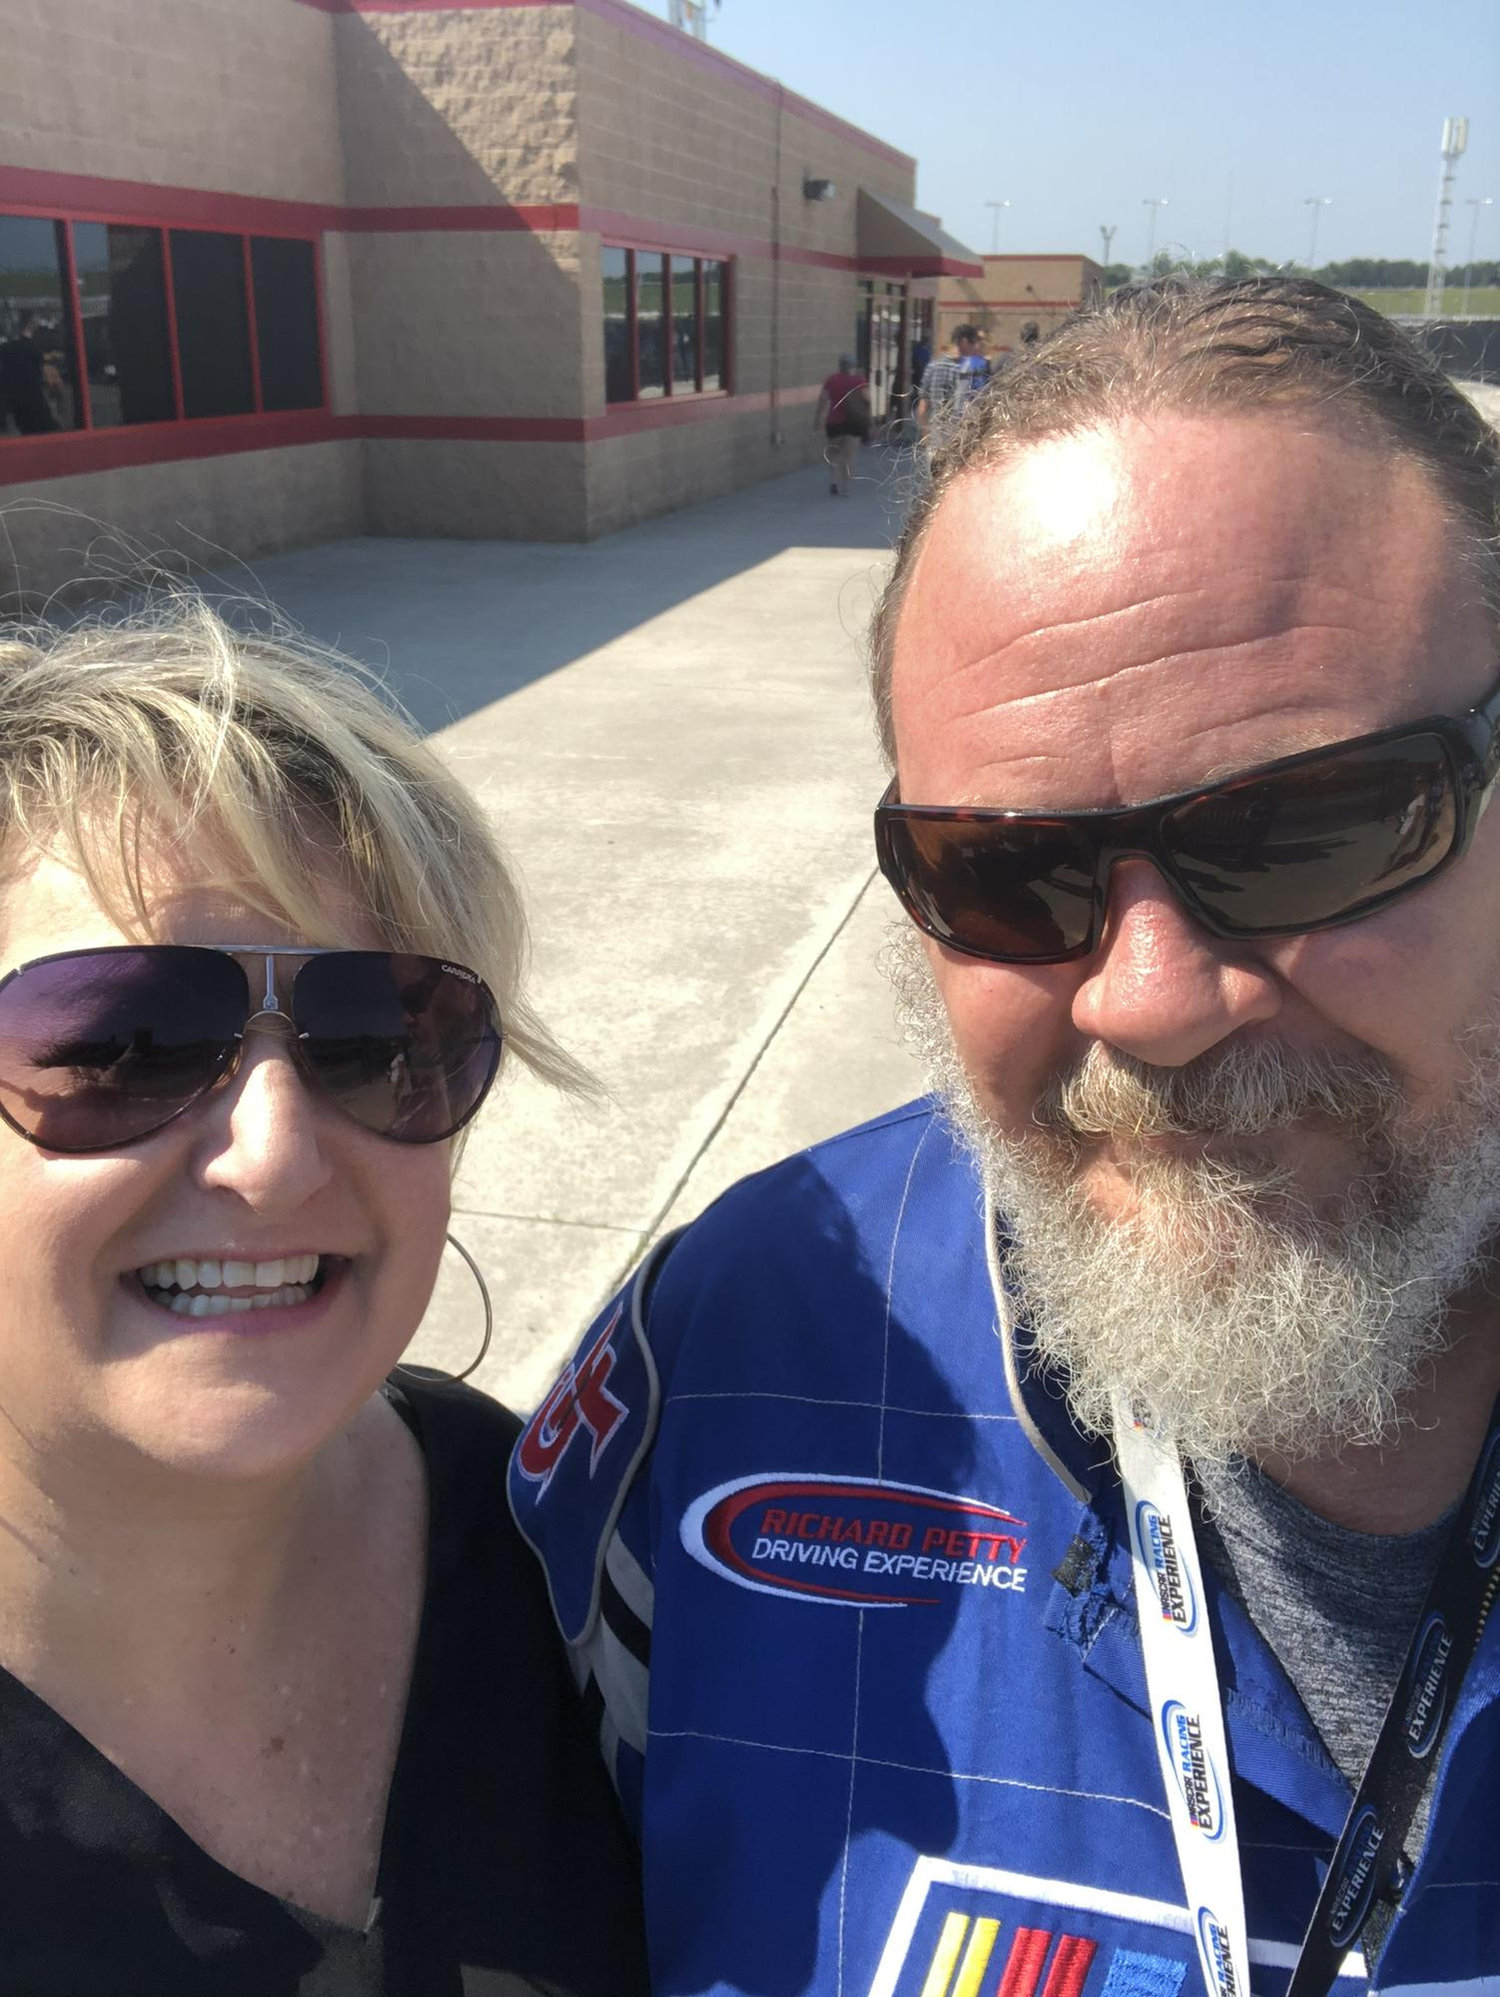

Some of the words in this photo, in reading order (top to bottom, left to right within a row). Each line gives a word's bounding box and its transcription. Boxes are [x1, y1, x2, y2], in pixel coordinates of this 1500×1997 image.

[760, 1508, 912, 1550] RICHARD
[922, 1529, 1027, 1564] PETTY
[1148, 1514, 1165, 1569] RACING
[1474, 1469, 1500, 1550] EXPERI
[752, 1537, 858, 1570] DRIVING
[863, 1552, 1027, 1592] EXPERIENCE
[1158, 1514, 1187, 1624] EXPERIENCE
[1408, 1634, 1453, 1742] EXPERIENCE
[1176, 1714, 1192, 1773] RACING
[1187, 1713, 1214, 1831] EXPERIENCE
[1331, 1826, 1385, 1933] EXPERIENCE
[1209, 1922, 1227, 1983] RACING
[1216, 1925, 1237, 1997] RIENCE
